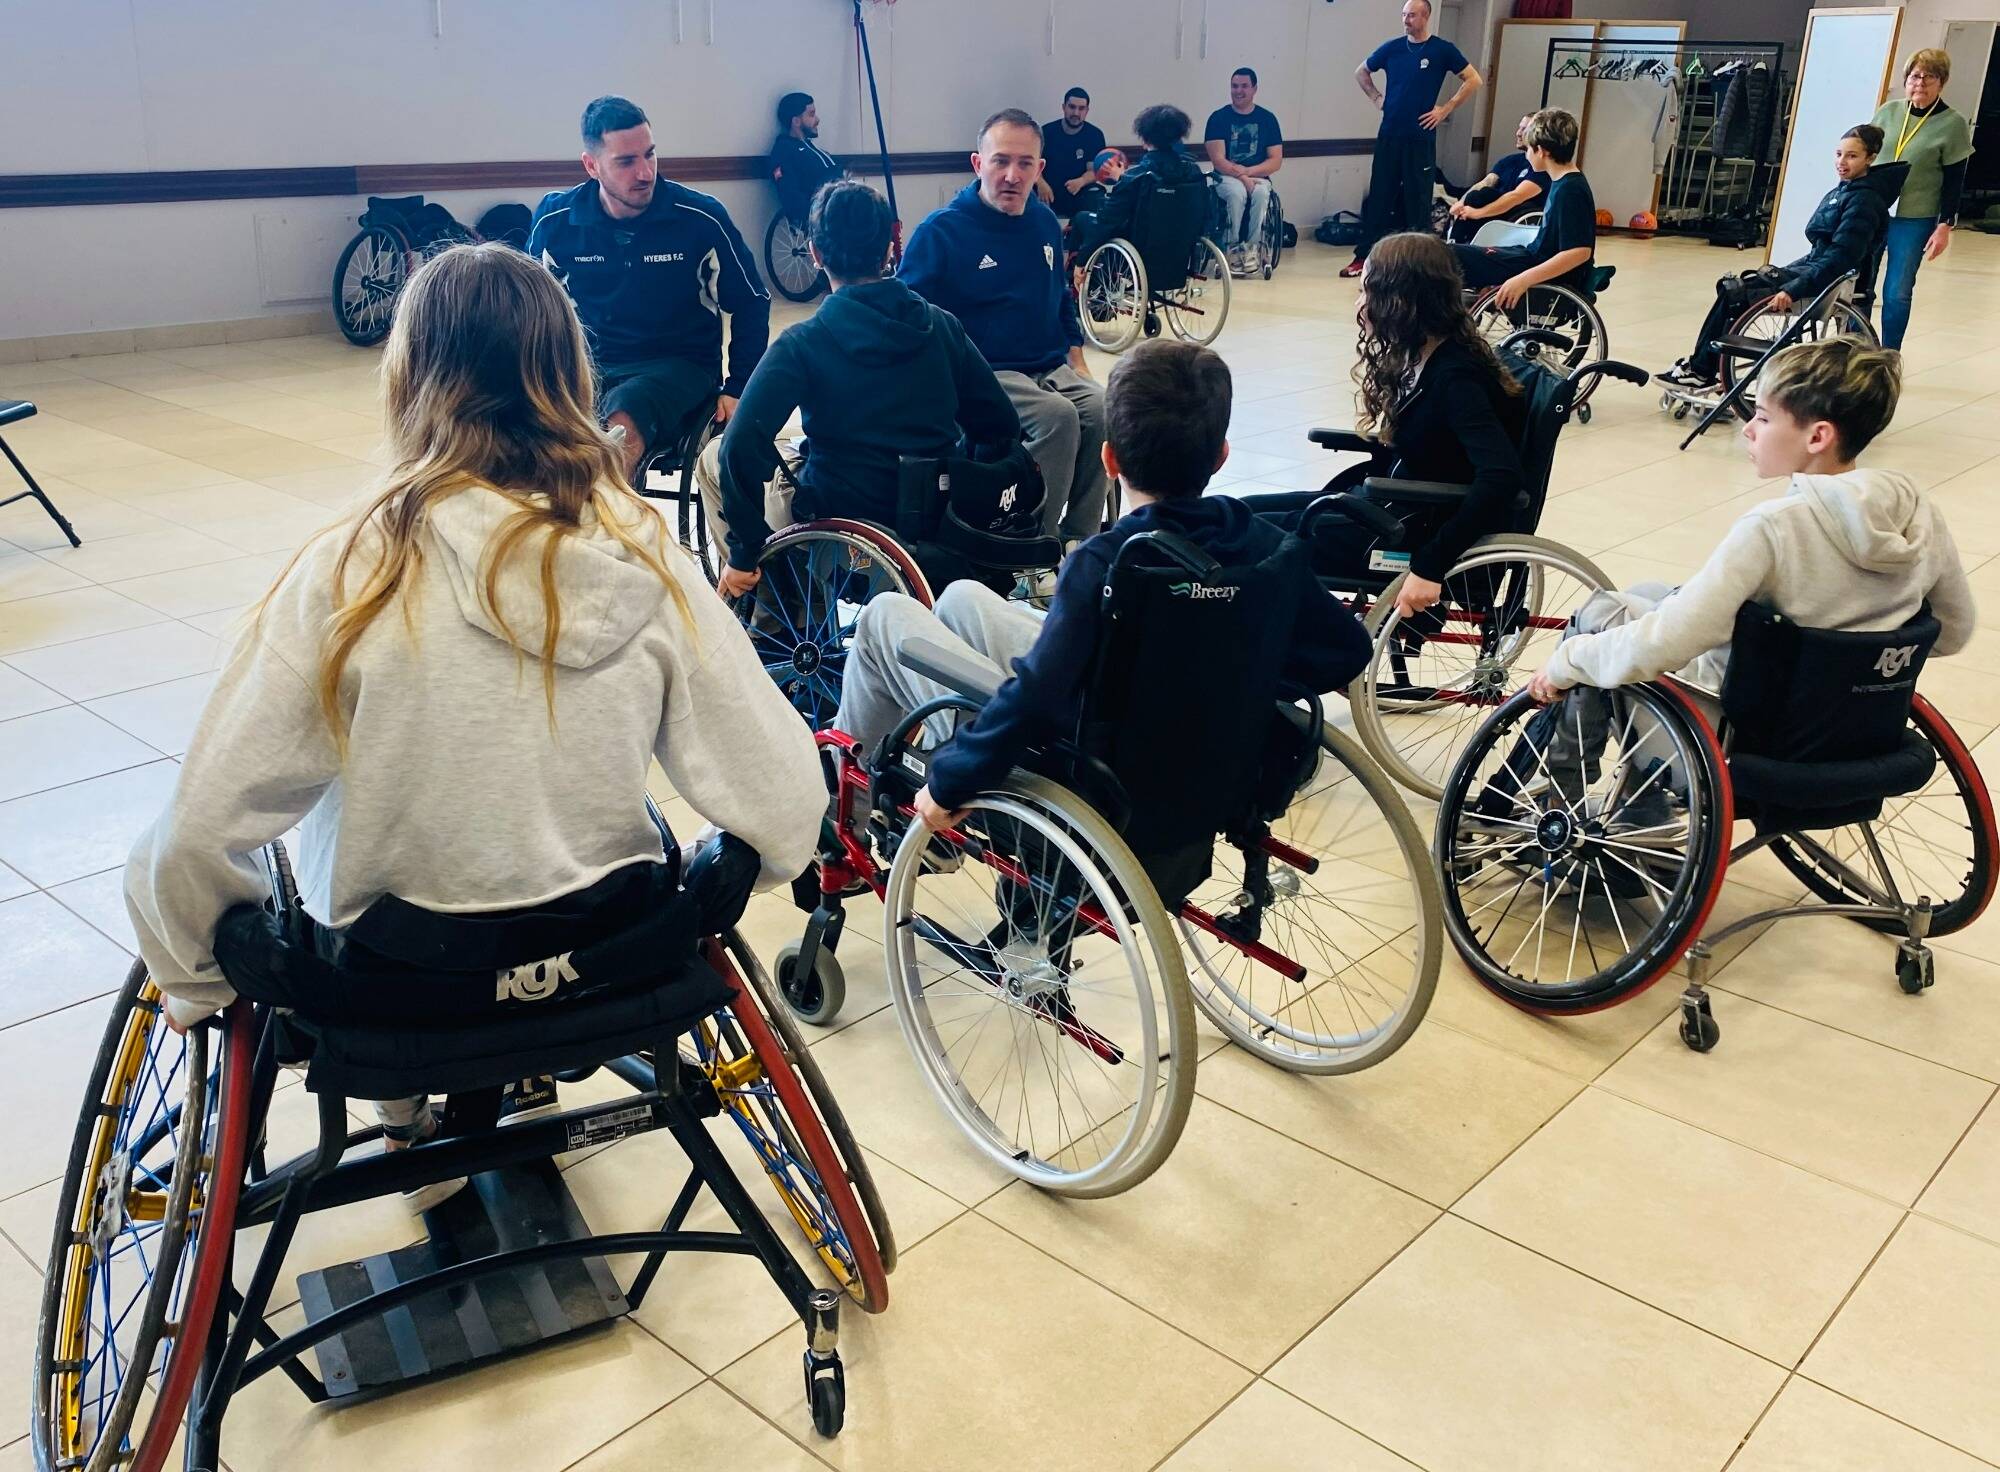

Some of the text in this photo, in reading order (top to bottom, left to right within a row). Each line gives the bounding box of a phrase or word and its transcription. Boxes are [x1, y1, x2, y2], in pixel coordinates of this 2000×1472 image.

[574, 254, 605, 263] macron
[643, 253, 672, 263] HYERES
[1189, 582, 1238, 603] Breezy
